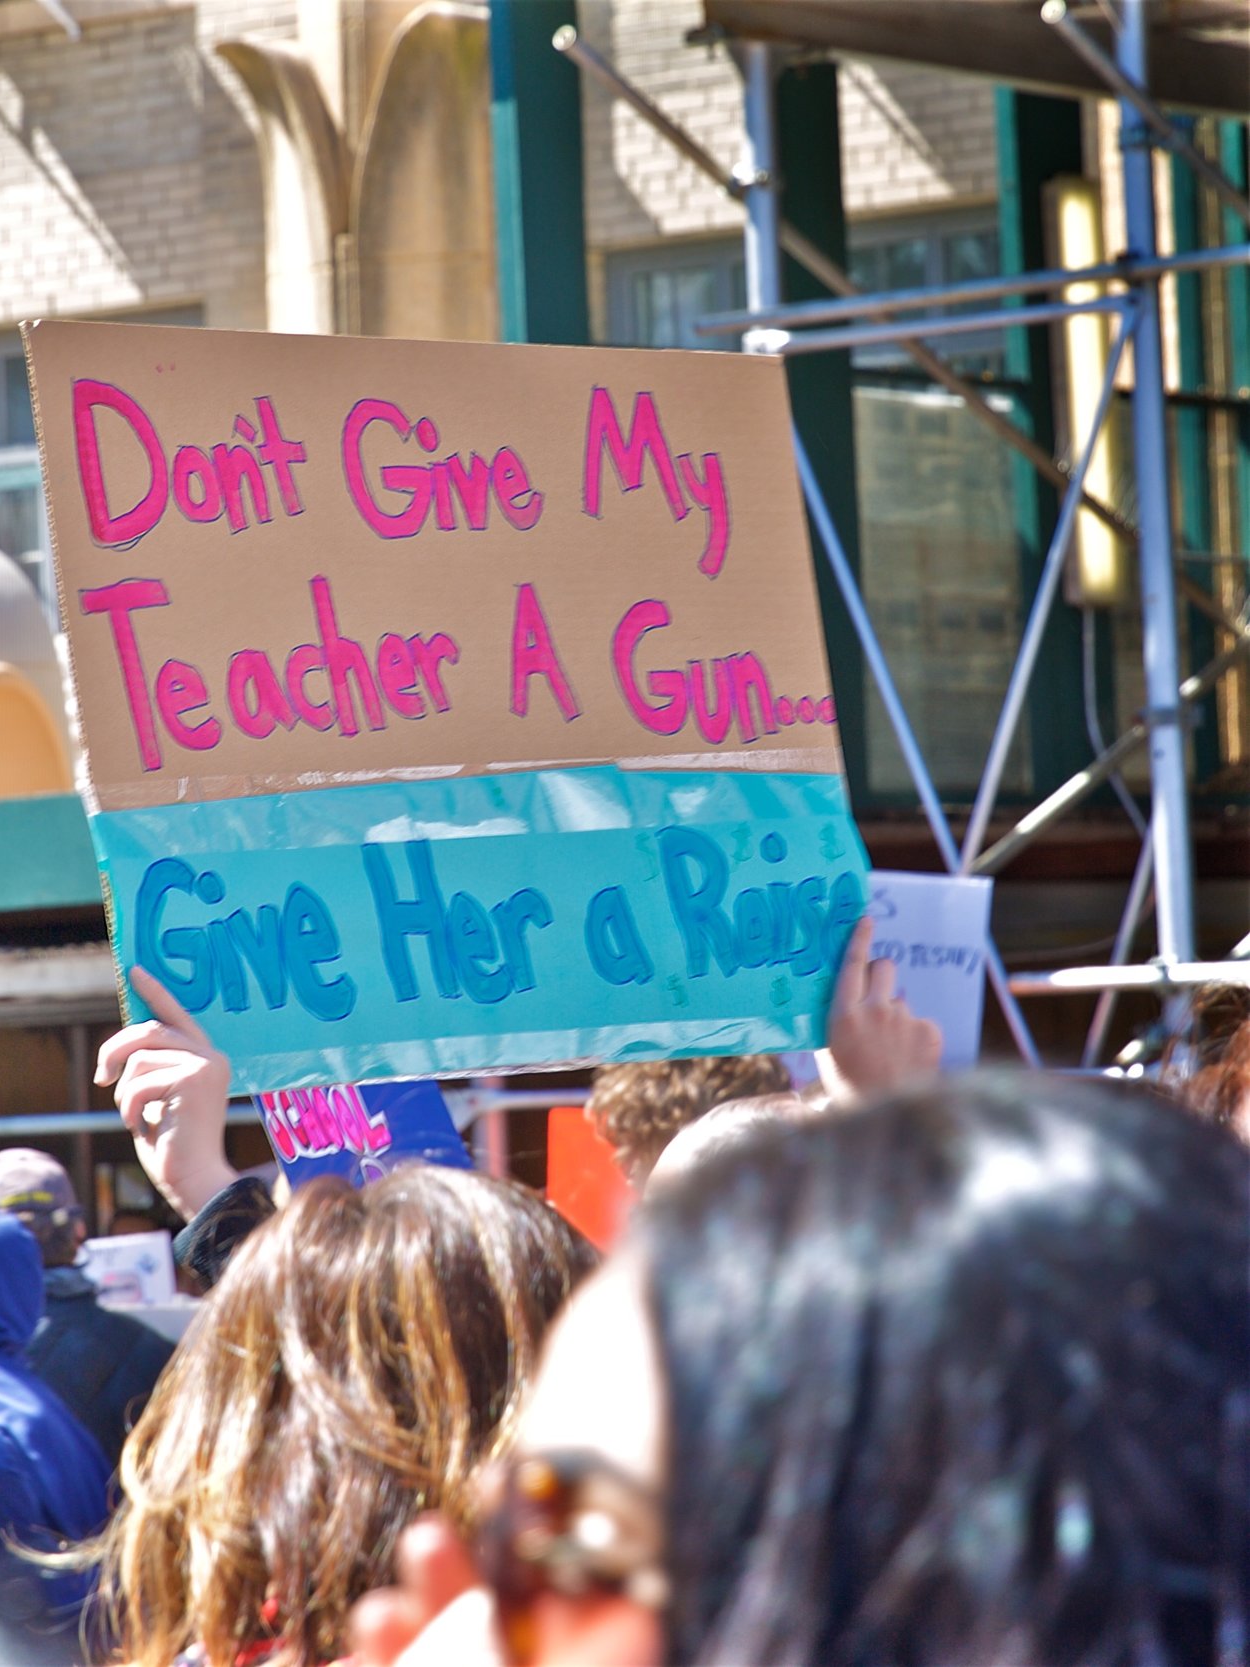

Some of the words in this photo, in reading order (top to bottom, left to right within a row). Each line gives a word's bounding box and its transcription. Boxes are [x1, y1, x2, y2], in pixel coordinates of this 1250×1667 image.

[72, 379, 306, 550] Don't
[342, 398, 543, 540] Give
[582, 386, 729, 578] My
[81, 574, 458, 772] Teacher
[510, 582, 581, 722] A
[612, 599, 836, 744] Gun...
[134, 856, 358, 1022] Give
[360, 838, 555, 1005] Her
[583, 884, 655, 986] a
[654, 825, 866, 979] Raise
